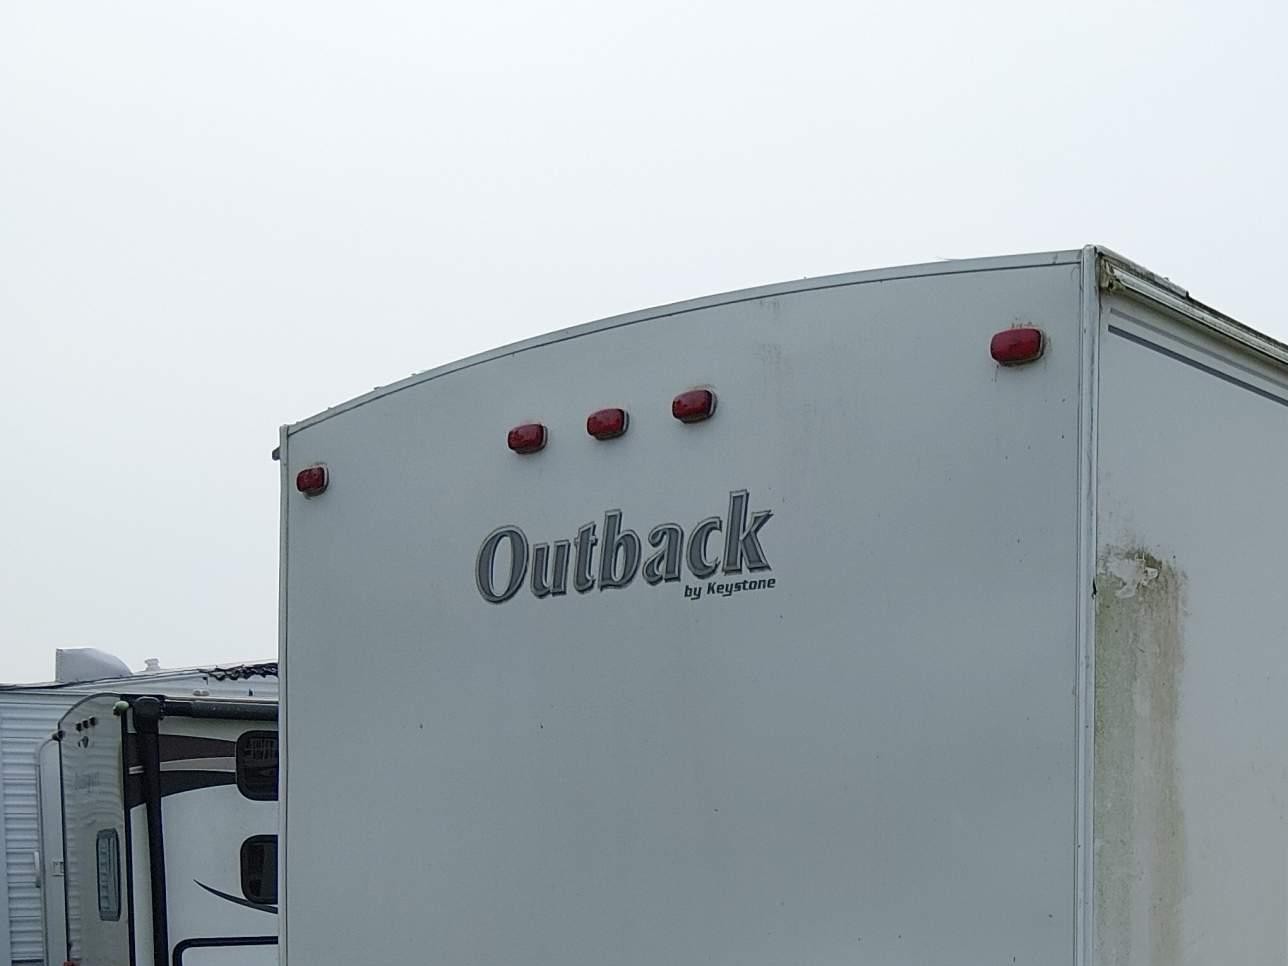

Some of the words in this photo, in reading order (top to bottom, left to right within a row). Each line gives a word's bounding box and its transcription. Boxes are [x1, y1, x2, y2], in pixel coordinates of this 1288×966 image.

[474, 488, 775, 605] Outback
[684, 584, 702, 601] by
[706, 578, 776, 597] Keystone
